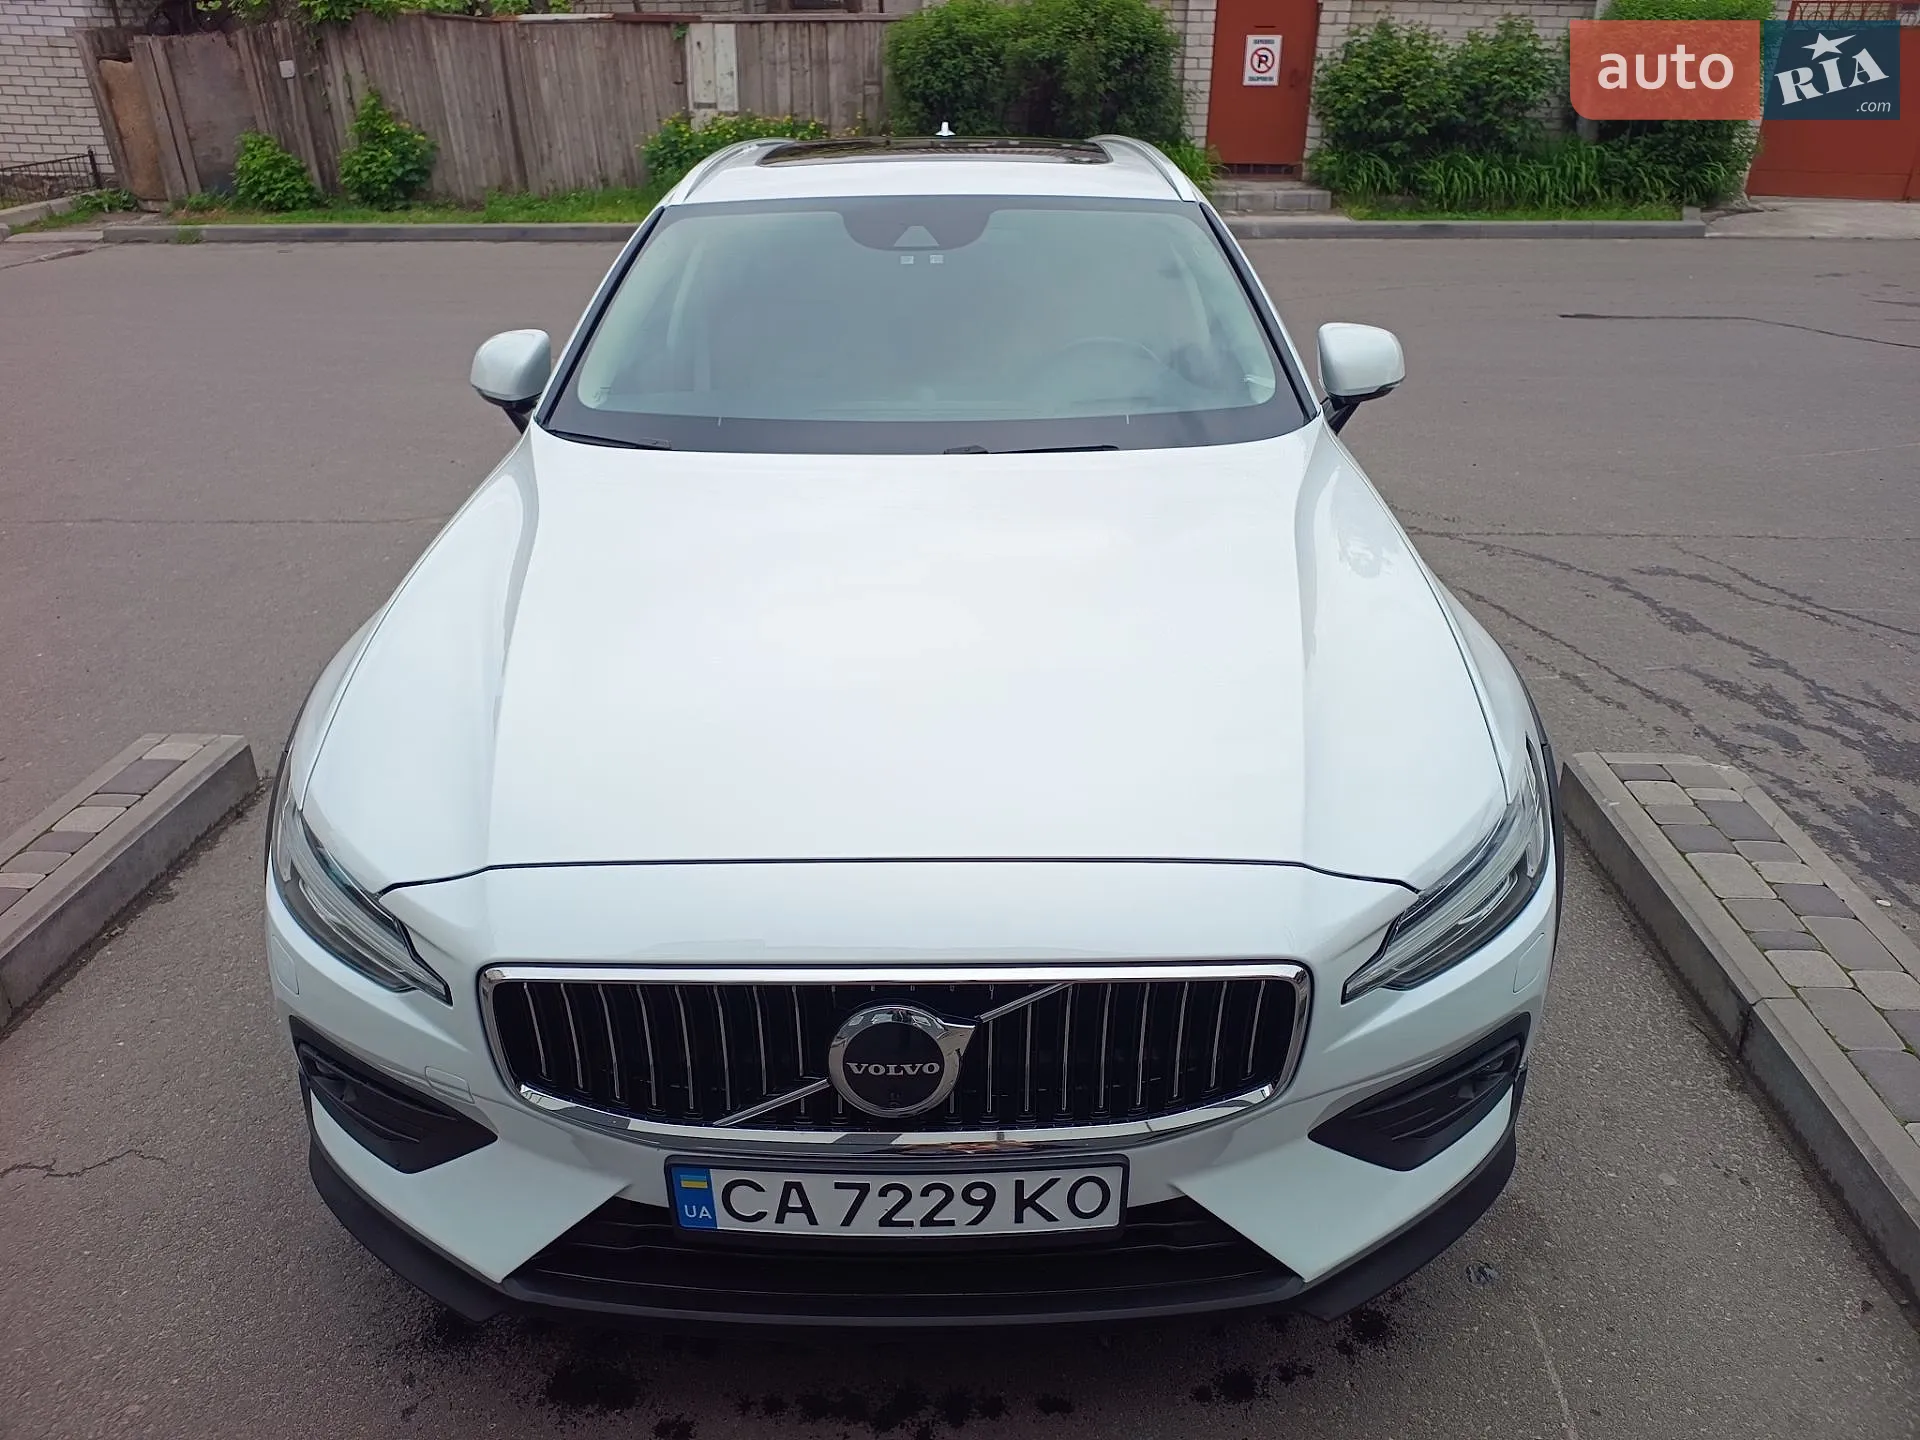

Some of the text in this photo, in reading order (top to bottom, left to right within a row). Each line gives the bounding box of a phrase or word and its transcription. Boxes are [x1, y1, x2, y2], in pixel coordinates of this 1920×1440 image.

[846, 1062, 940, 1076] VOLVO
[720, 1175, 1112, 1228] CA 7229 KO
[683, 1204, 712, 1220] UA
